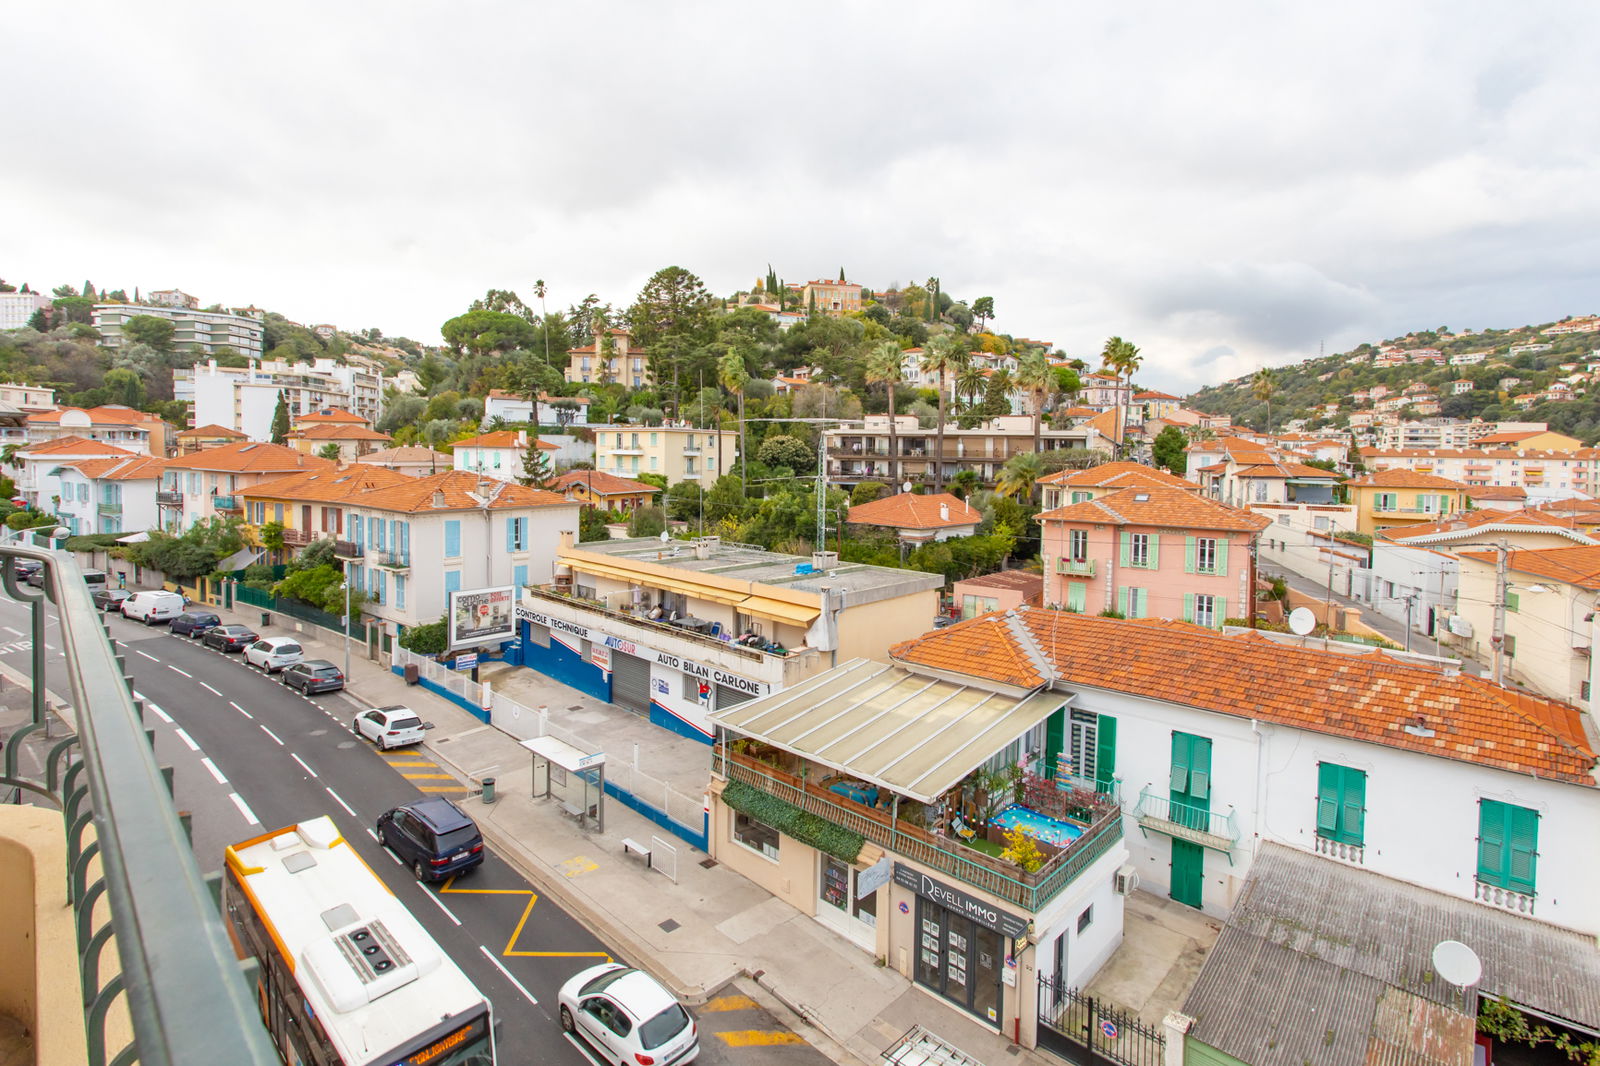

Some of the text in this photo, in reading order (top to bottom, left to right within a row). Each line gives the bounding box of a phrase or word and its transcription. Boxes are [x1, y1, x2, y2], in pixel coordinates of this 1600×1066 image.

[457, 594, 480, 603] como
[463, 599, 489, 608] cucine
[515, 607, 588, 638] CONTROLE TECHNIQUE
[604, 636, 636, 655] AUTOSUR
[657, 653, 760, 695] AUTO BILAN CARLONE
[921, 874, 964, 909] REVELL
[965, 901, 998, 923] IMMO
